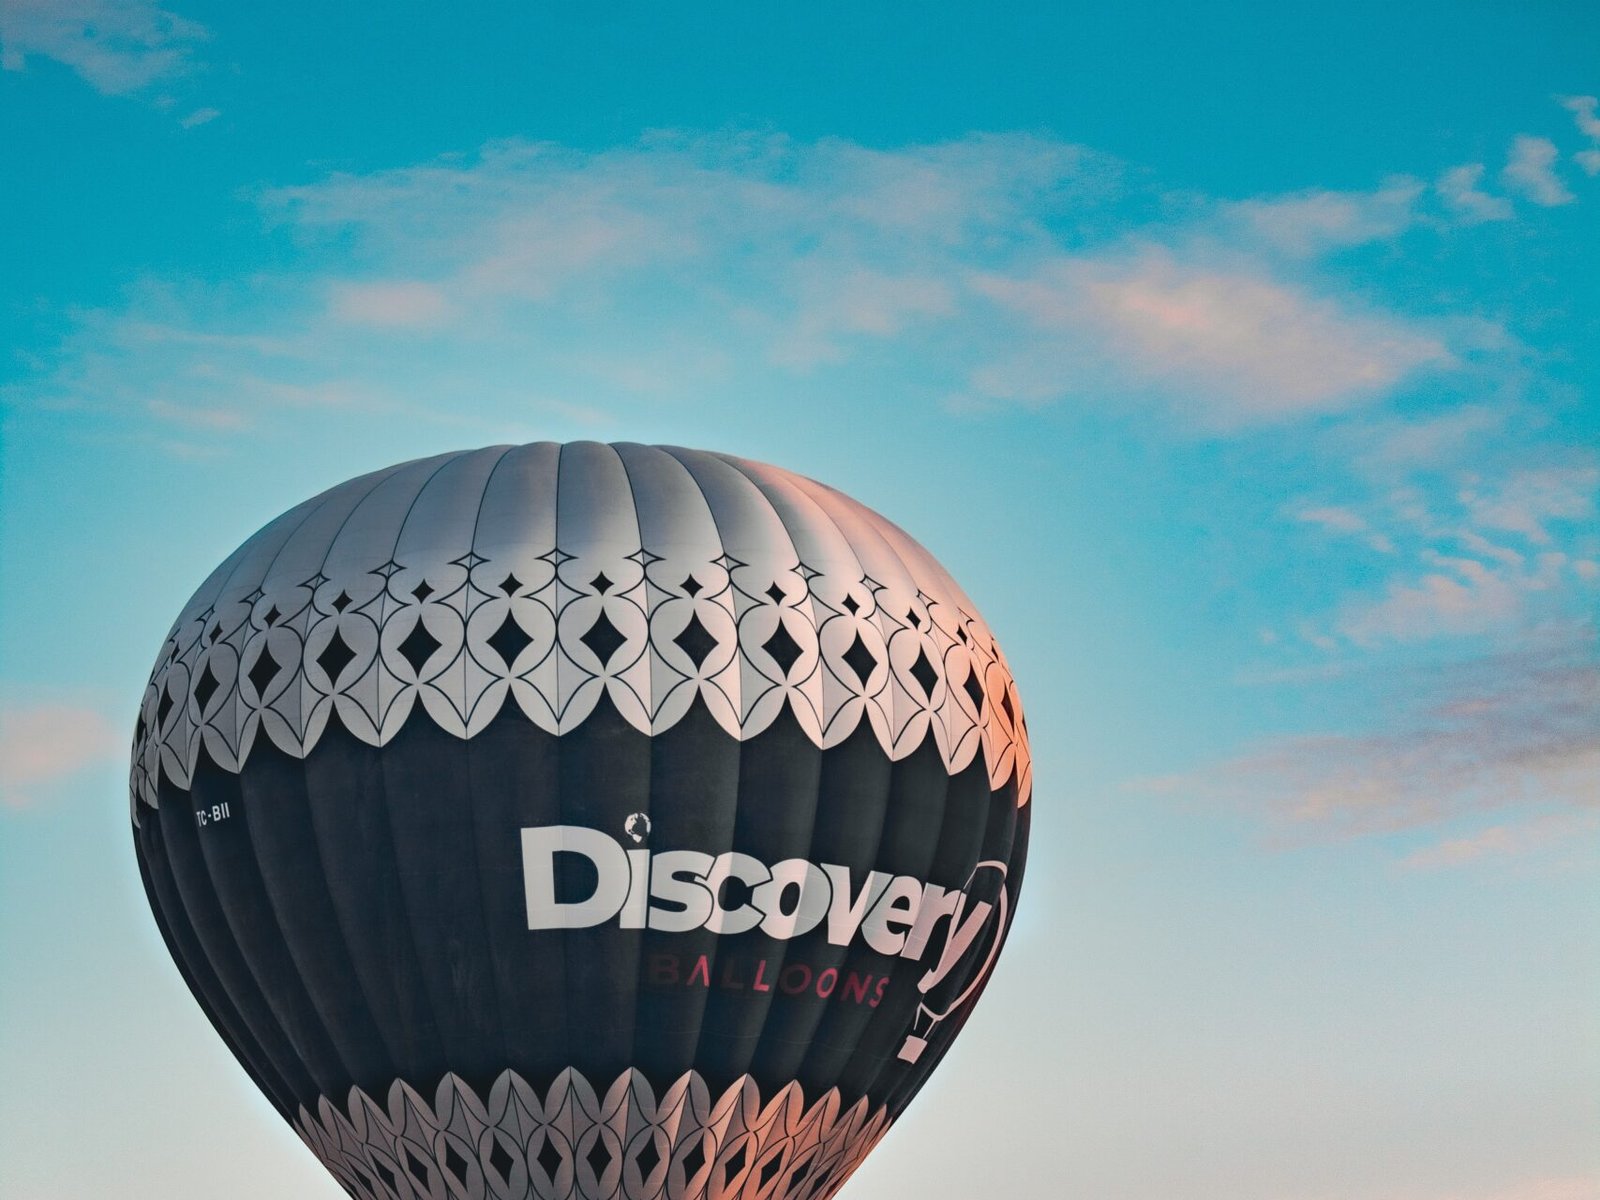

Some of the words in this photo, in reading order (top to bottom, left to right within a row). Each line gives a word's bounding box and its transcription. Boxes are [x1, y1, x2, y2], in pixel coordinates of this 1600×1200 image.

[195, 802, 231, 827] TC-BII
[520, 812, 992, 993] Discovery
[648, 954, 891, 1008] BALLOONS
